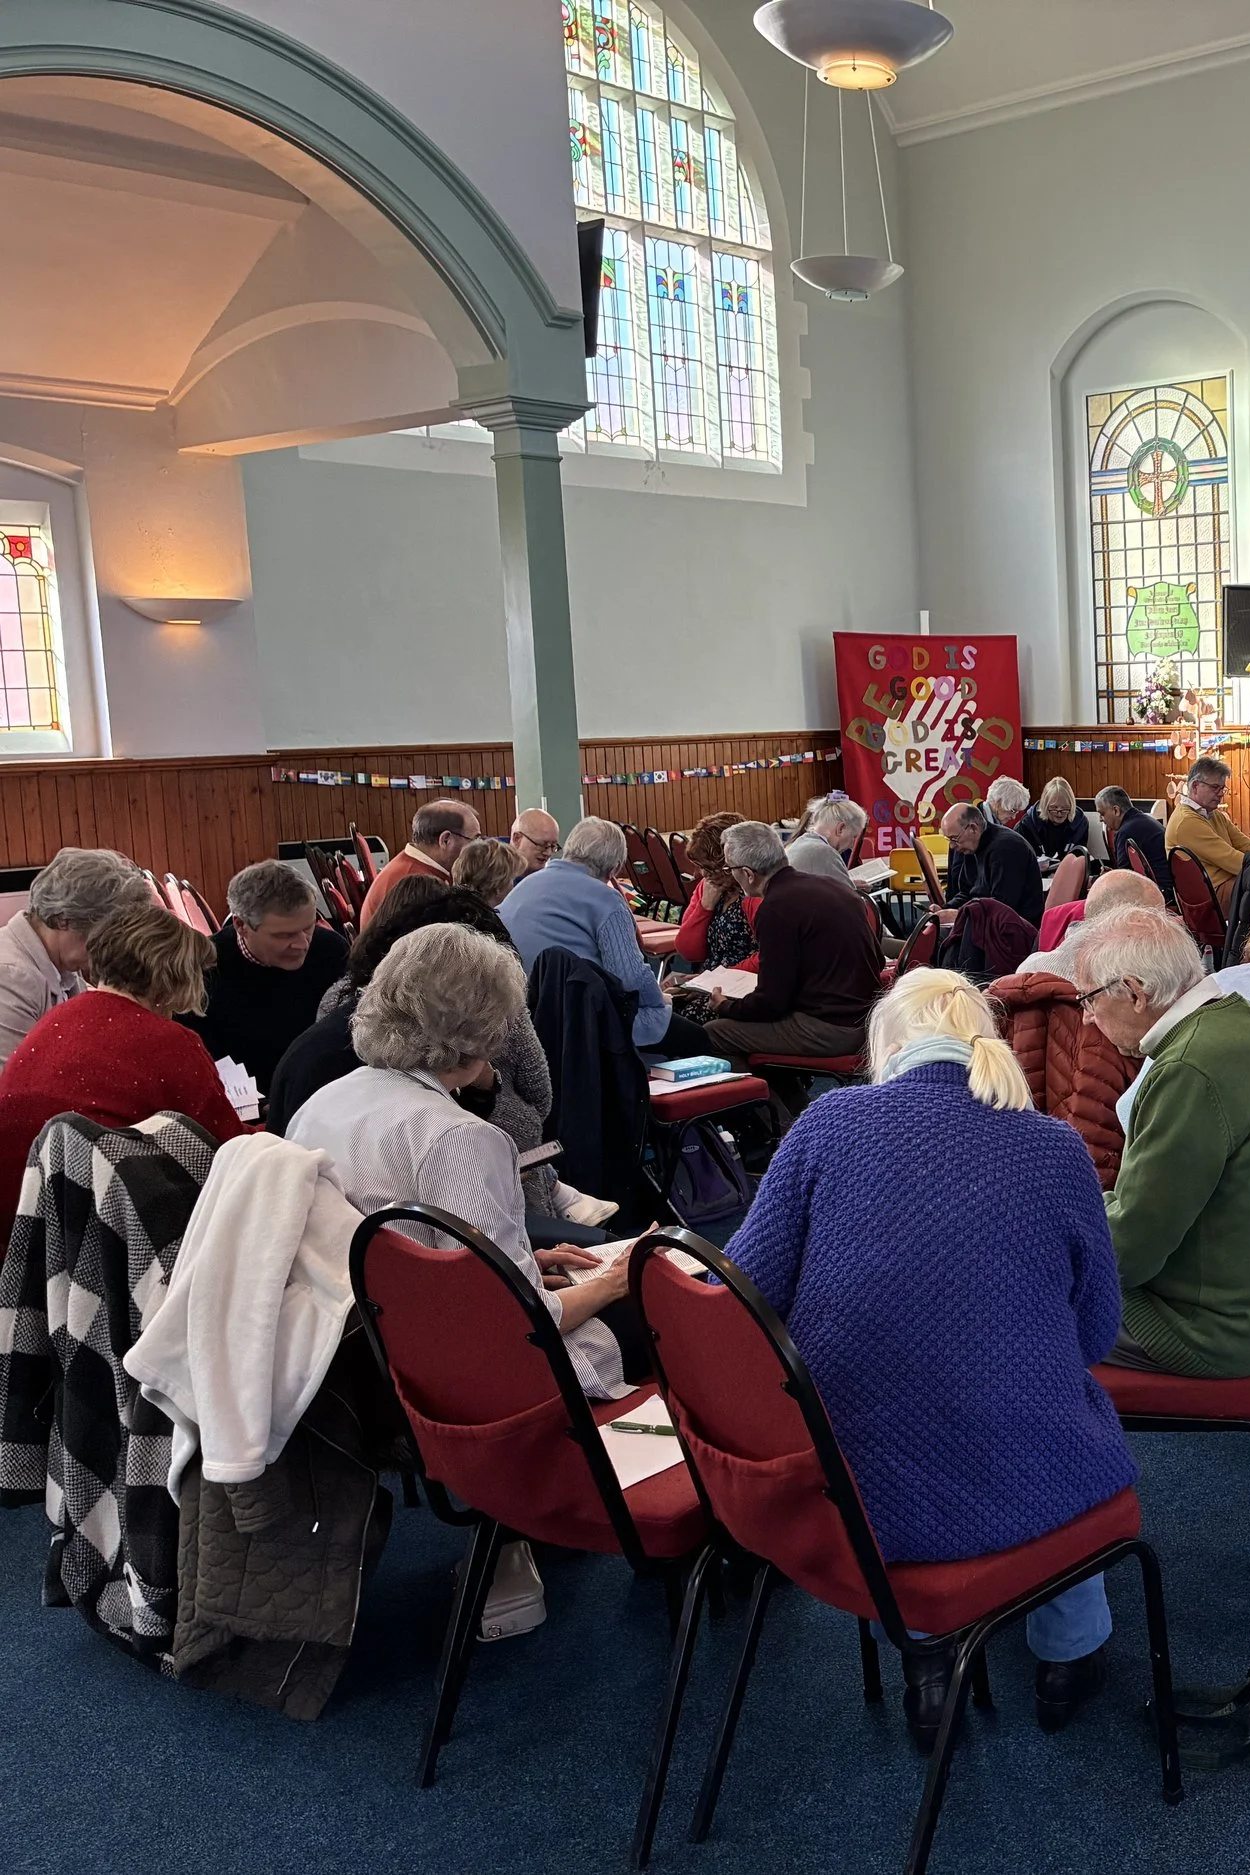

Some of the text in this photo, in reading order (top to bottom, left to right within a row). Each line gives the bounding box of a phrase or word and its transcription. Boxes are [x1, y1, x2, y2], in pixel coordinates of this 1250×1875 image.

[868, 645, 978, 670] GOD IS
[890, 676, 978, 701] GOOD
[866, 717, 977, 747] GOD IS
[881, 749, 974, 774] GREAT
[873, 799, 937, 824] GOD
